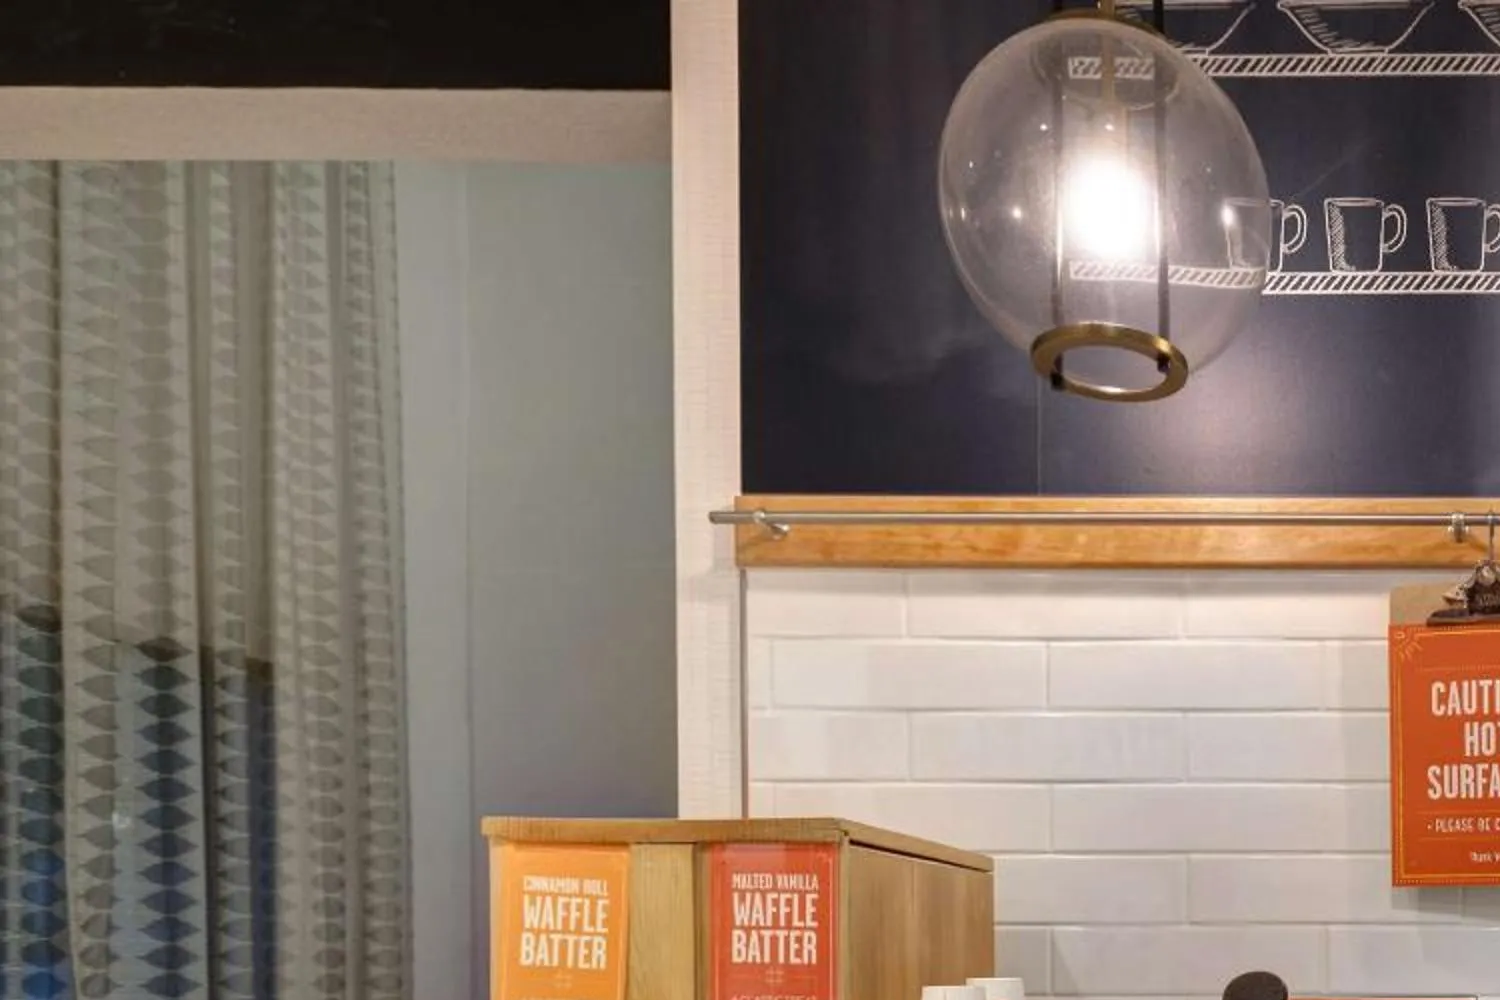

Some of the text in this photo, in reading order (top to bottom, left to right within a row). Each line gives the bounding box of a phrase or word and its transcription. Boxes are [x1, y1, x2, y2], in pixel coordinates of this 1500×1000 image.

[1435, 817, 1473, 833] PLEASE
[731, 873, 819, 890] MALTED VANILLA
[524, 895, 609, 932] WAFFLE
[732, 892, 819, 927] WAFFLE
[520, 931, 608, 969] BATTER
[731, 929, 817, 965] BATTER
